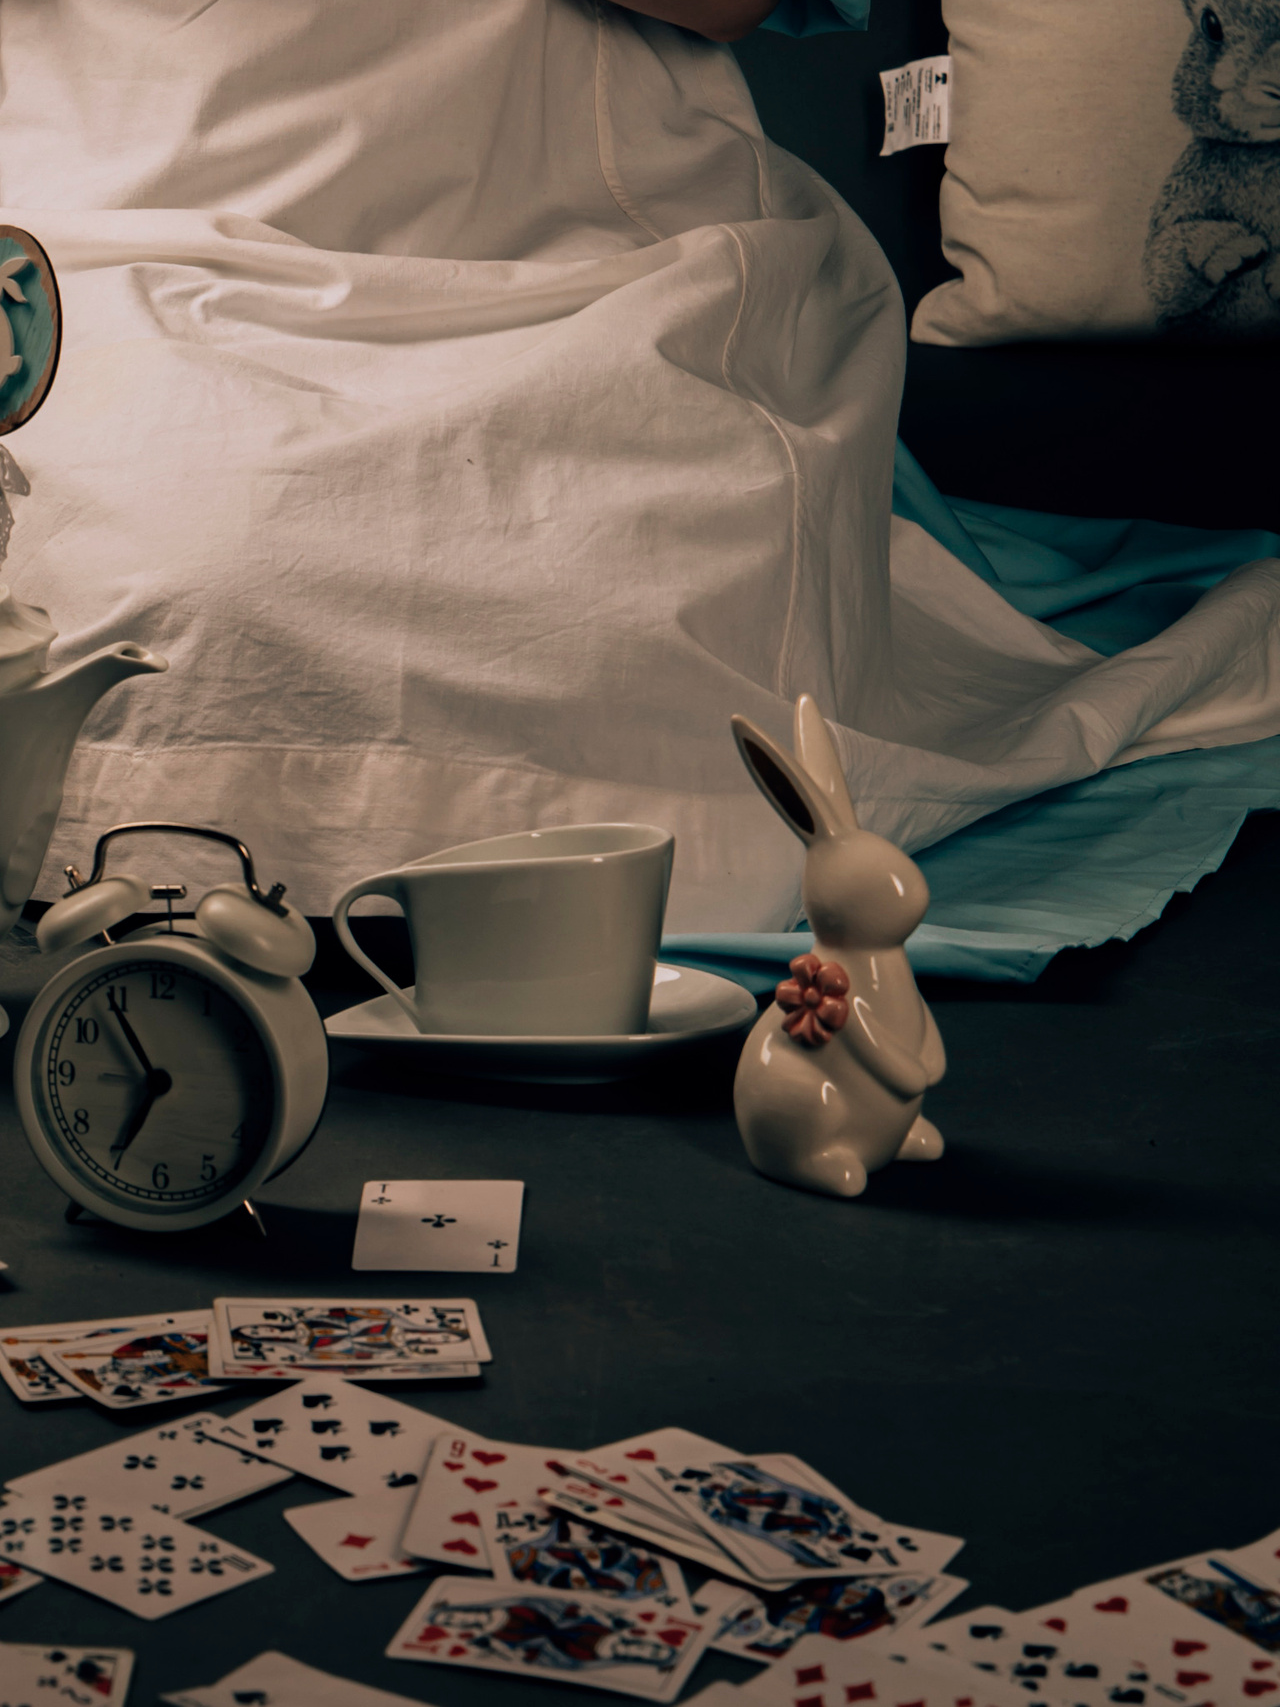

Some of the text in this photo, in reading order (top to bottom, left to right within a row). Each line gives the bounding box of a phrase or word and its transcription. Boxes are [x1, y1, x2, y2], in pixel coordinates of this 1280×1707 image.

[107, 986, 127, 1012] 11
[150, 973, 176, 1000] 12
[202, 990, 213, 1016] 1
[75, 1018, 99, 1044] 10
[234, 1025, 250, 1053] 2
[58, 1060, 75, 1086] 9
[73, 1109, 90, 1134] 8
[231, 1122, 246, 1150] 4
[109, 1145, 126, 1170] 7
[200, 1155, 217, 1181] 5
[152, 1163, 169, 1190] 6
